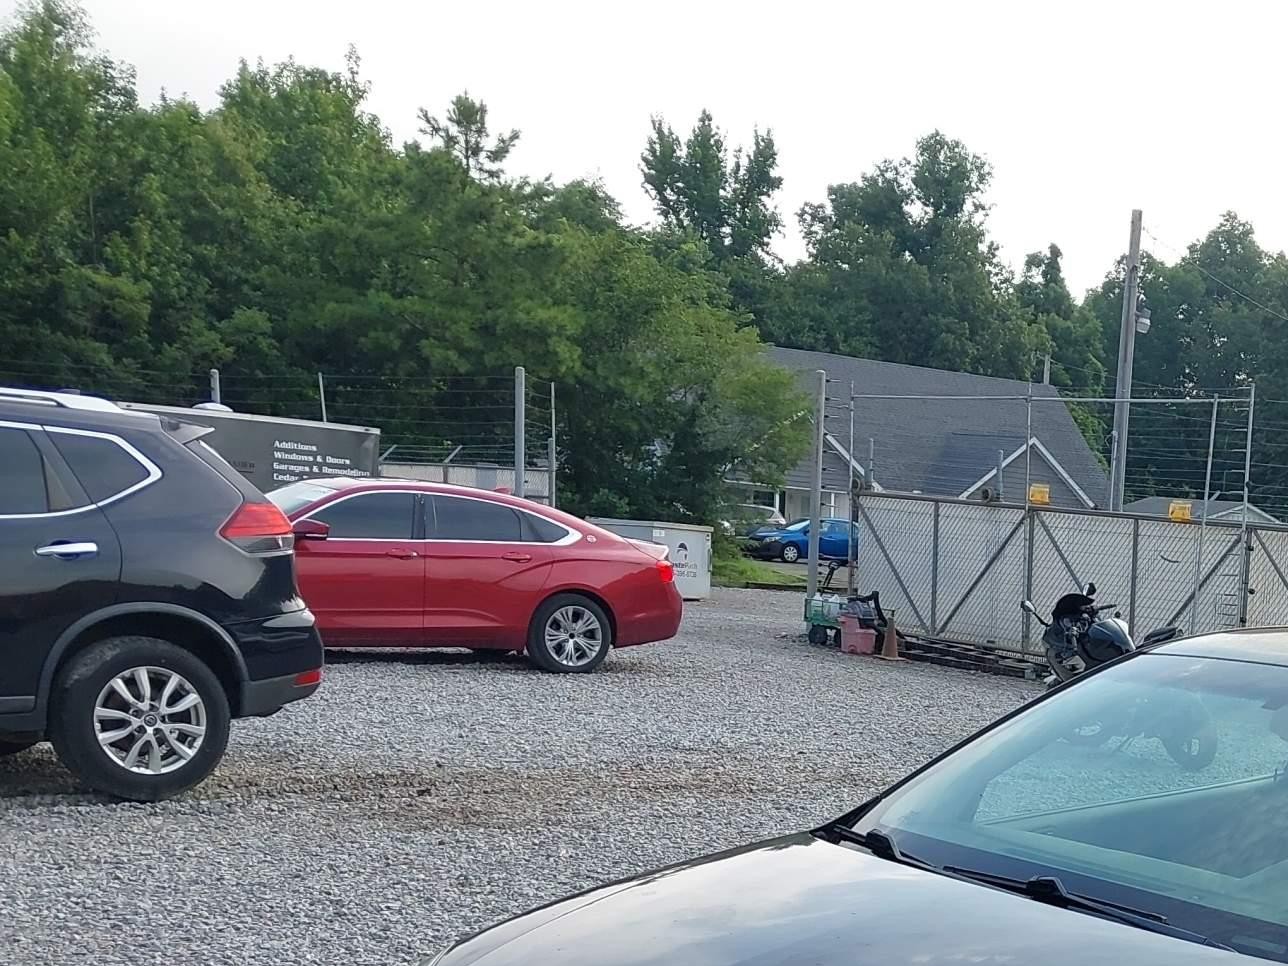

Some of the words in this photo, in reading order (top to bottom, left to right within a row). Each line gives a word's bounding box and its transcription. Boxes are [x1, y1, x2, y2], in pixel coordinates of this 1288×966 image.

[273, 440, 317, 452] Additions
[273, 451, 314, 462] Windows
[316, 455, 323, 463] &
[326, 456, 350, 465] Doors
[273, 462, 310, 473] Garages
[312, 465, 320, 473] &
[273, 472, 299, 481] Cedar
